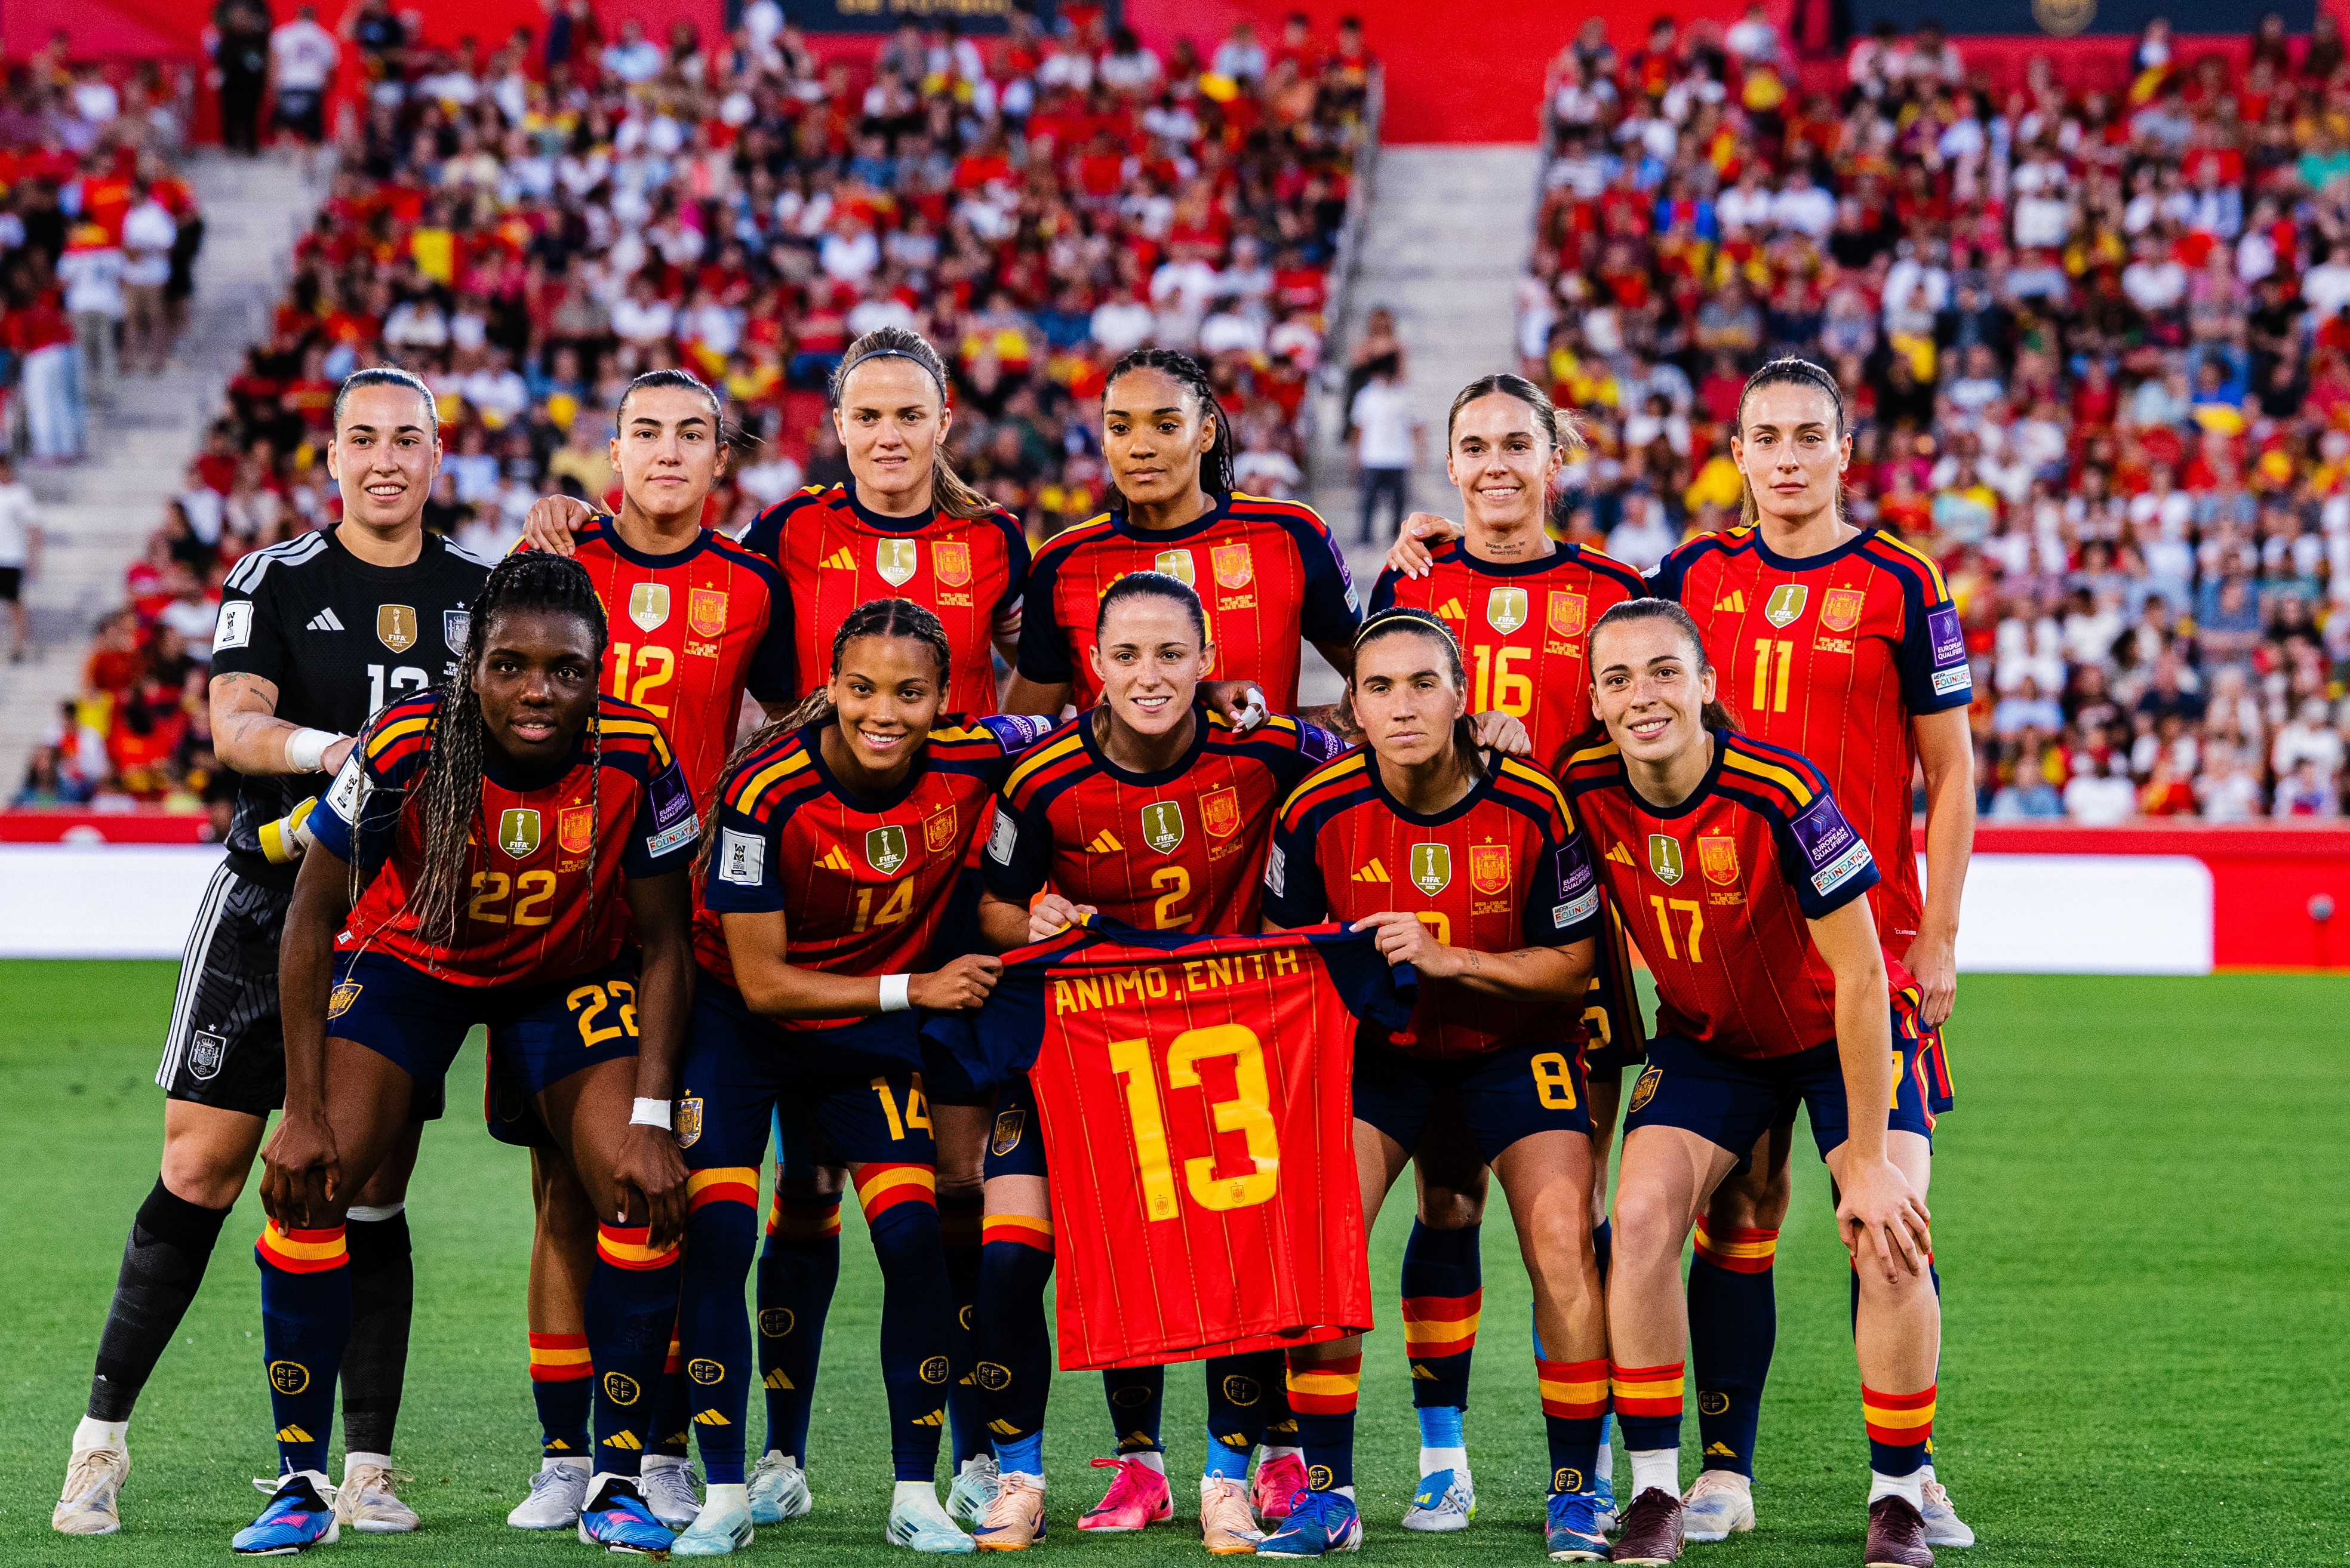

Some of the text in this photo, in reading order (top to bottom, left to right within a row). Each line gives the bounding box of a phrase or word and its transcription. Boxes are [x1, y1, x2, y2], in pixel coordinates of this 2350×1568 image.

[1937, 640, 1961, 653] EUROPEAN
[1937, 647, 1963, 660] QUALIFIERS
[613, 642, 674, 718] 12
[1474, 645, 1532, 717] 16
[1752, 638, 1794, 713] 11
[659, 793, 685, 817] EUROPEAN
[660, 800, 687, 822] QUALIFIERS
[1156, 834, 1174, 842] FIFA
[1811, 826, 1845, 855] EUROPEAN
[1814, 831, 1848, 861] QUALIFIERS
[1816, 827, 1836, 844] women's
[879, 854, 897, 863] FIFA
[1562, 865, 1589, 886] EUROPEAN
[1660, 866, 1675, 874] FIFA
[1813, 871, 1828, 882] UEFA
[1562, 871, 1591, 892] QUALIFIERS
[469, 870, 556, 925] 22
[853, 876, 914, 932] 14
[1151, 866, 1193, 929] 2
[1650, 895, 1703, 963] 17
[1183, 946, 1300, 992] ENITH
[567, 981, 639, 1048] 22
[1531, 1052, 1577, 1110] 8
[870, 1072, 935, 1141] 14
[1108, 1024, 1279, 1222] 13
[277, 1367, 299, 1377] RF
[695, 1363, 715, 1372] RF
[695, 1371, 714, 1379] EF
[982, 1367, 1001, 1376] RF
[278, 1377, 298, 1388] EF
[611, 1378, 630, 1389] RF
[982, 1375, 1001, 1384] EF
[611, 1387, 630, 1398] EF
